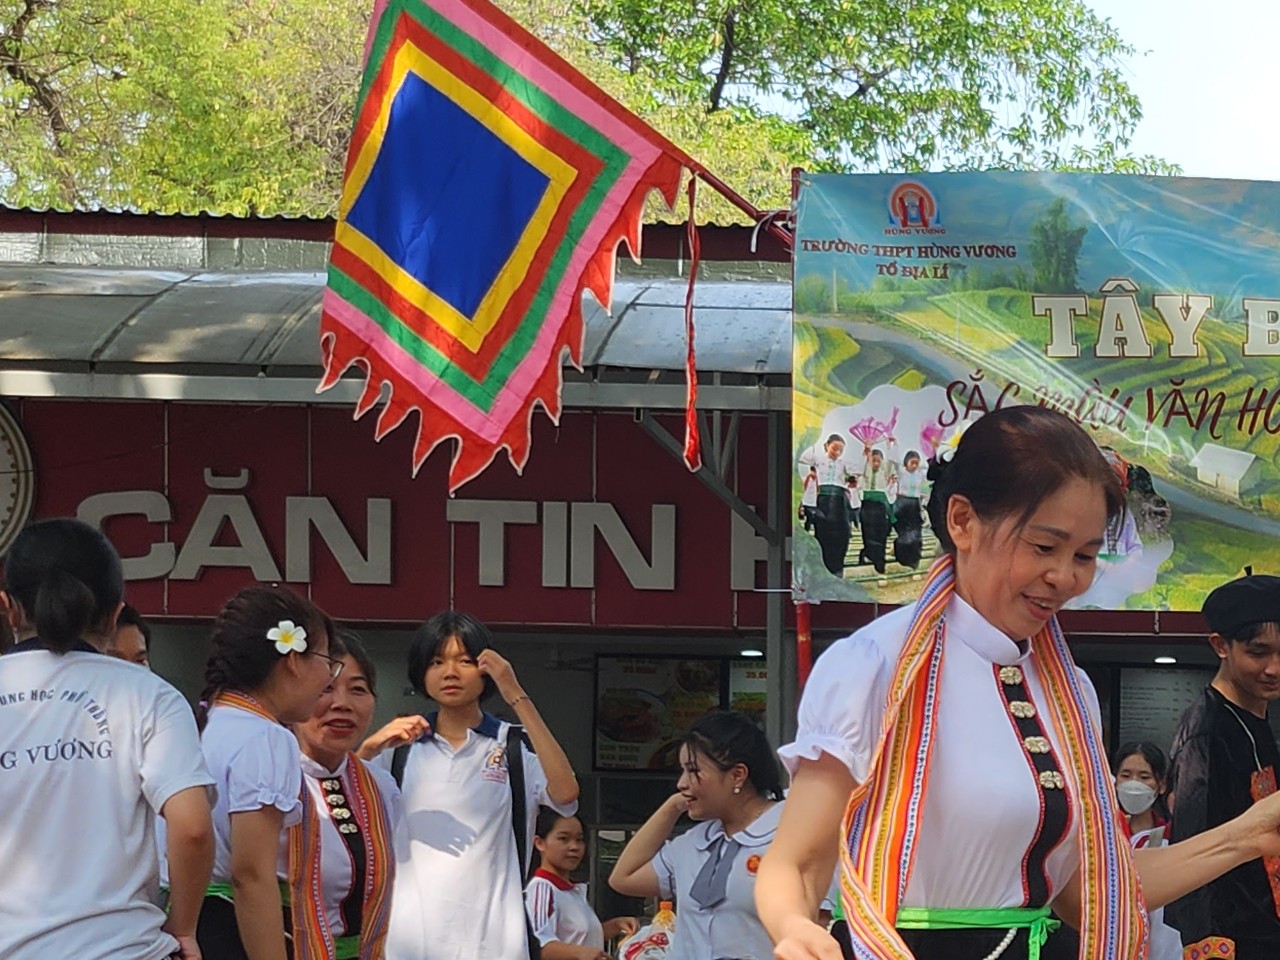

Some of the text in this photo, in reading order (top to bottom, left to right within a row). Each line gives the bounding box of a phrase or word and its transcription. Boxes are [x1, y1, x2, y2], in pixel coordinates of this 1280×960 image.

[801, 237, 1017, 259] TRƯỜNG THPT HÙNG VƯƠNG
[902, 265, 929, 280] ĐỊA
[932, 262, 949, 280] LÍ
[1031, 277, 1214, 360] TÂY
[76, 467, 393, 586] CĂN
[446, 500, 676, 592] TIN
[30, 688, 55, 702] HỌC
[26, 737, 113, 765] VƯƠNG
